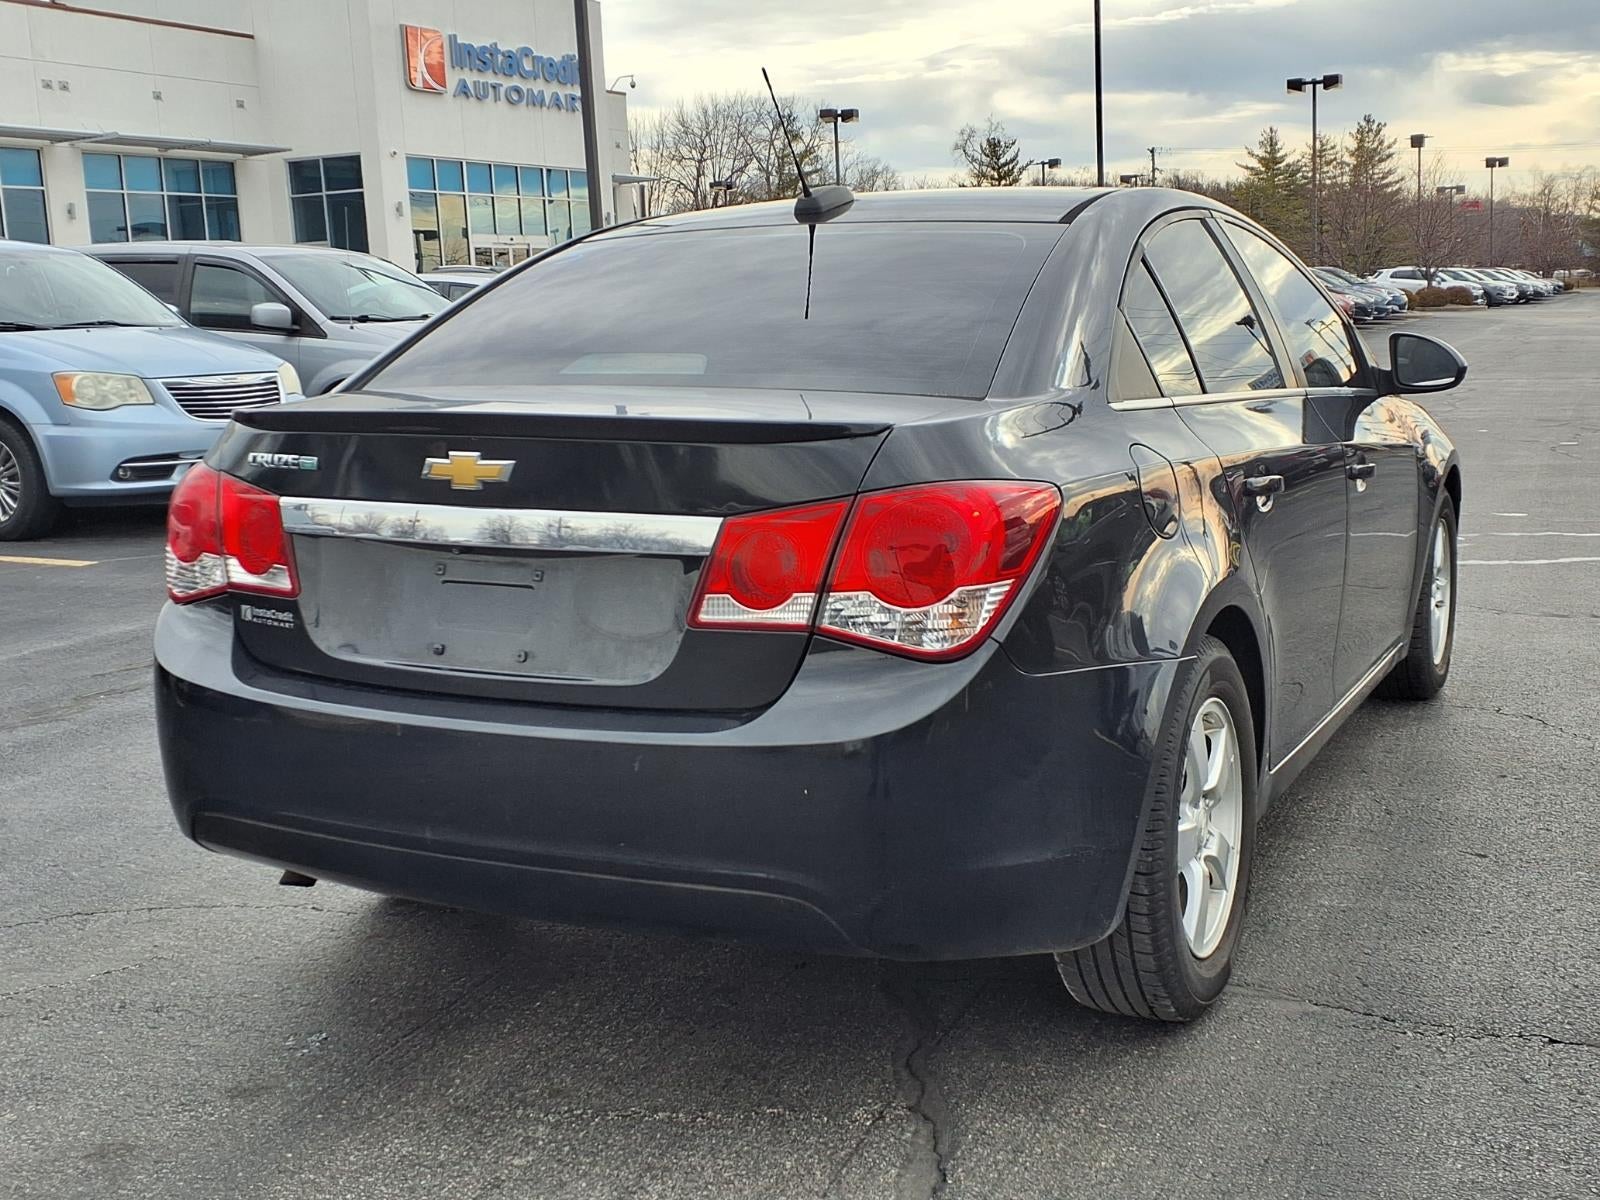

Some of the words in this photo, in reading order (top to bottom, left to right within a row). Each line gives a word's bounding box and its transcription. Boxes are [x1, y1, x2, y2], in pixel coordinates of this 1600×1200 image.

[448, 34, 580, 86] InstaCredi
[453, 78, 581, 112] AUTOMAR
[247, 452, 300, 469] CRUZE
